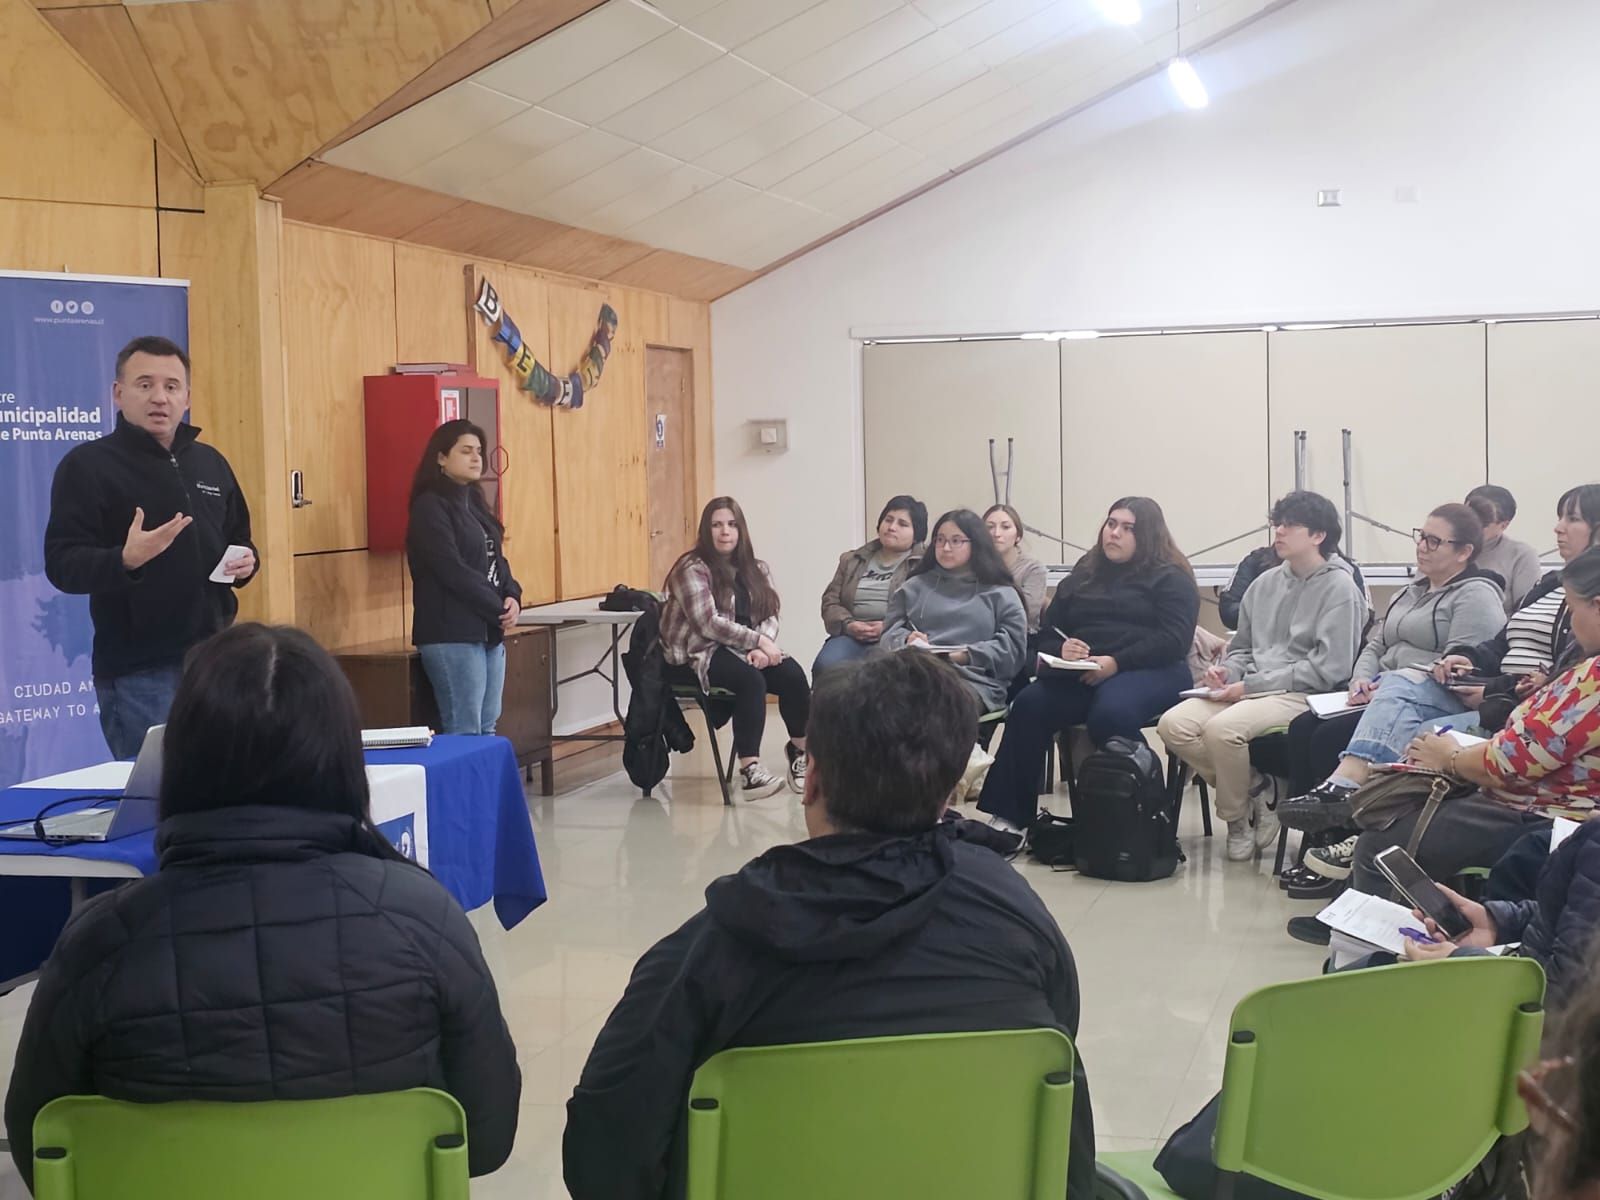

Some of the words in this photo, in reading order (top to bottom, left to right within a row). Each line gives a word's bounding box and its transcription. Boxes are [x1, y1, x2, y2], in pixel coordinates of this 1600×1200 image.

[0, 406, 100, 427] nicipalidad
[0, 430, 10, 441] e
[13, 427, 52, 440] Punta
[55, 428, 102, 441] Arenas
[14, 681, 71, 698] CIUDAD
[66, 703, 86, 717] TO
